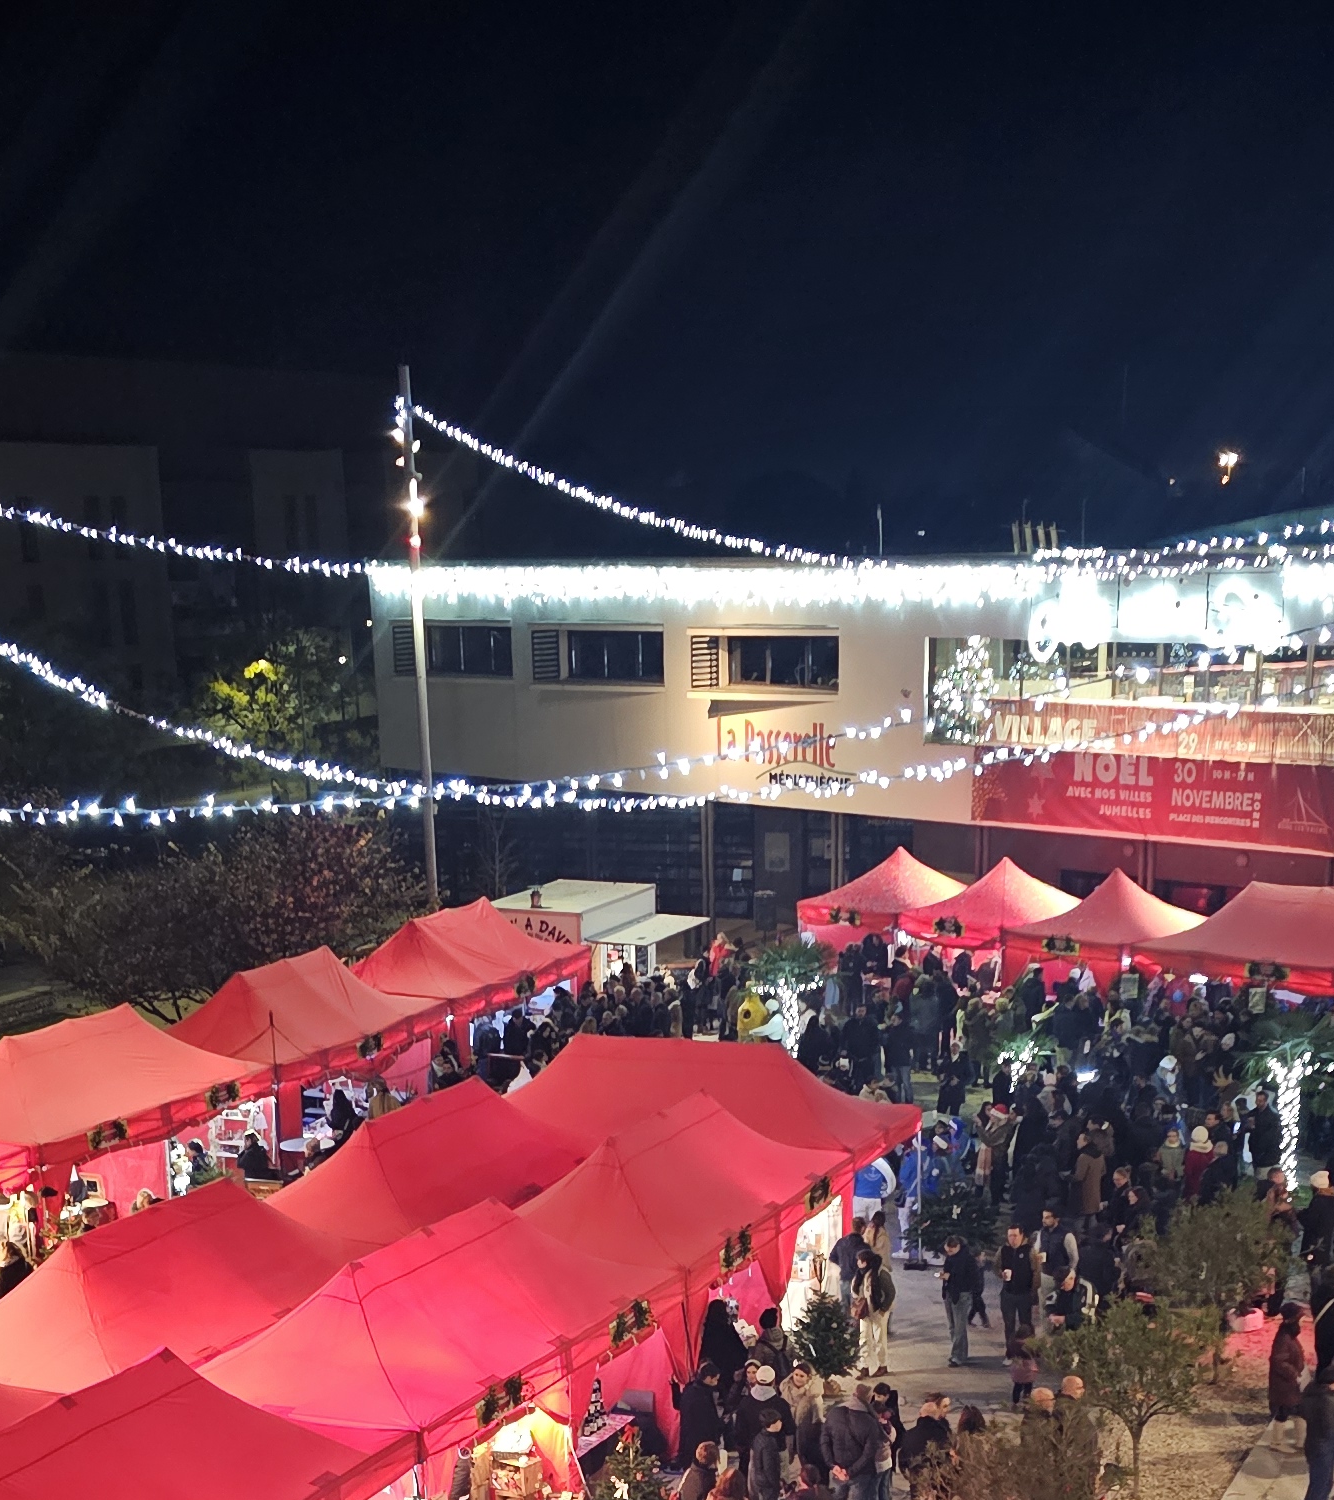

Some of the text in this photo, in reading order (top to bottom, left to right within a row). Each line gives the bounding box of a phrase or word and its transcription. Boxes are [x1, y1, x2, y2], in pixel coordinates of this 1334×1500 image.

[995, 711, 1097, 745] VILLAGE
[745, 719, 836, 768] Passerelle
[1177, 732, 1198, 754] 29
[1174, 762, 1196, 783] 30
[1066, 786, 1152, 803] AVEC NOS VILLES
[1171, 788, 1253, 811] NOVEMBRE
[1099, 804, 1152, 819] JUMELLES
